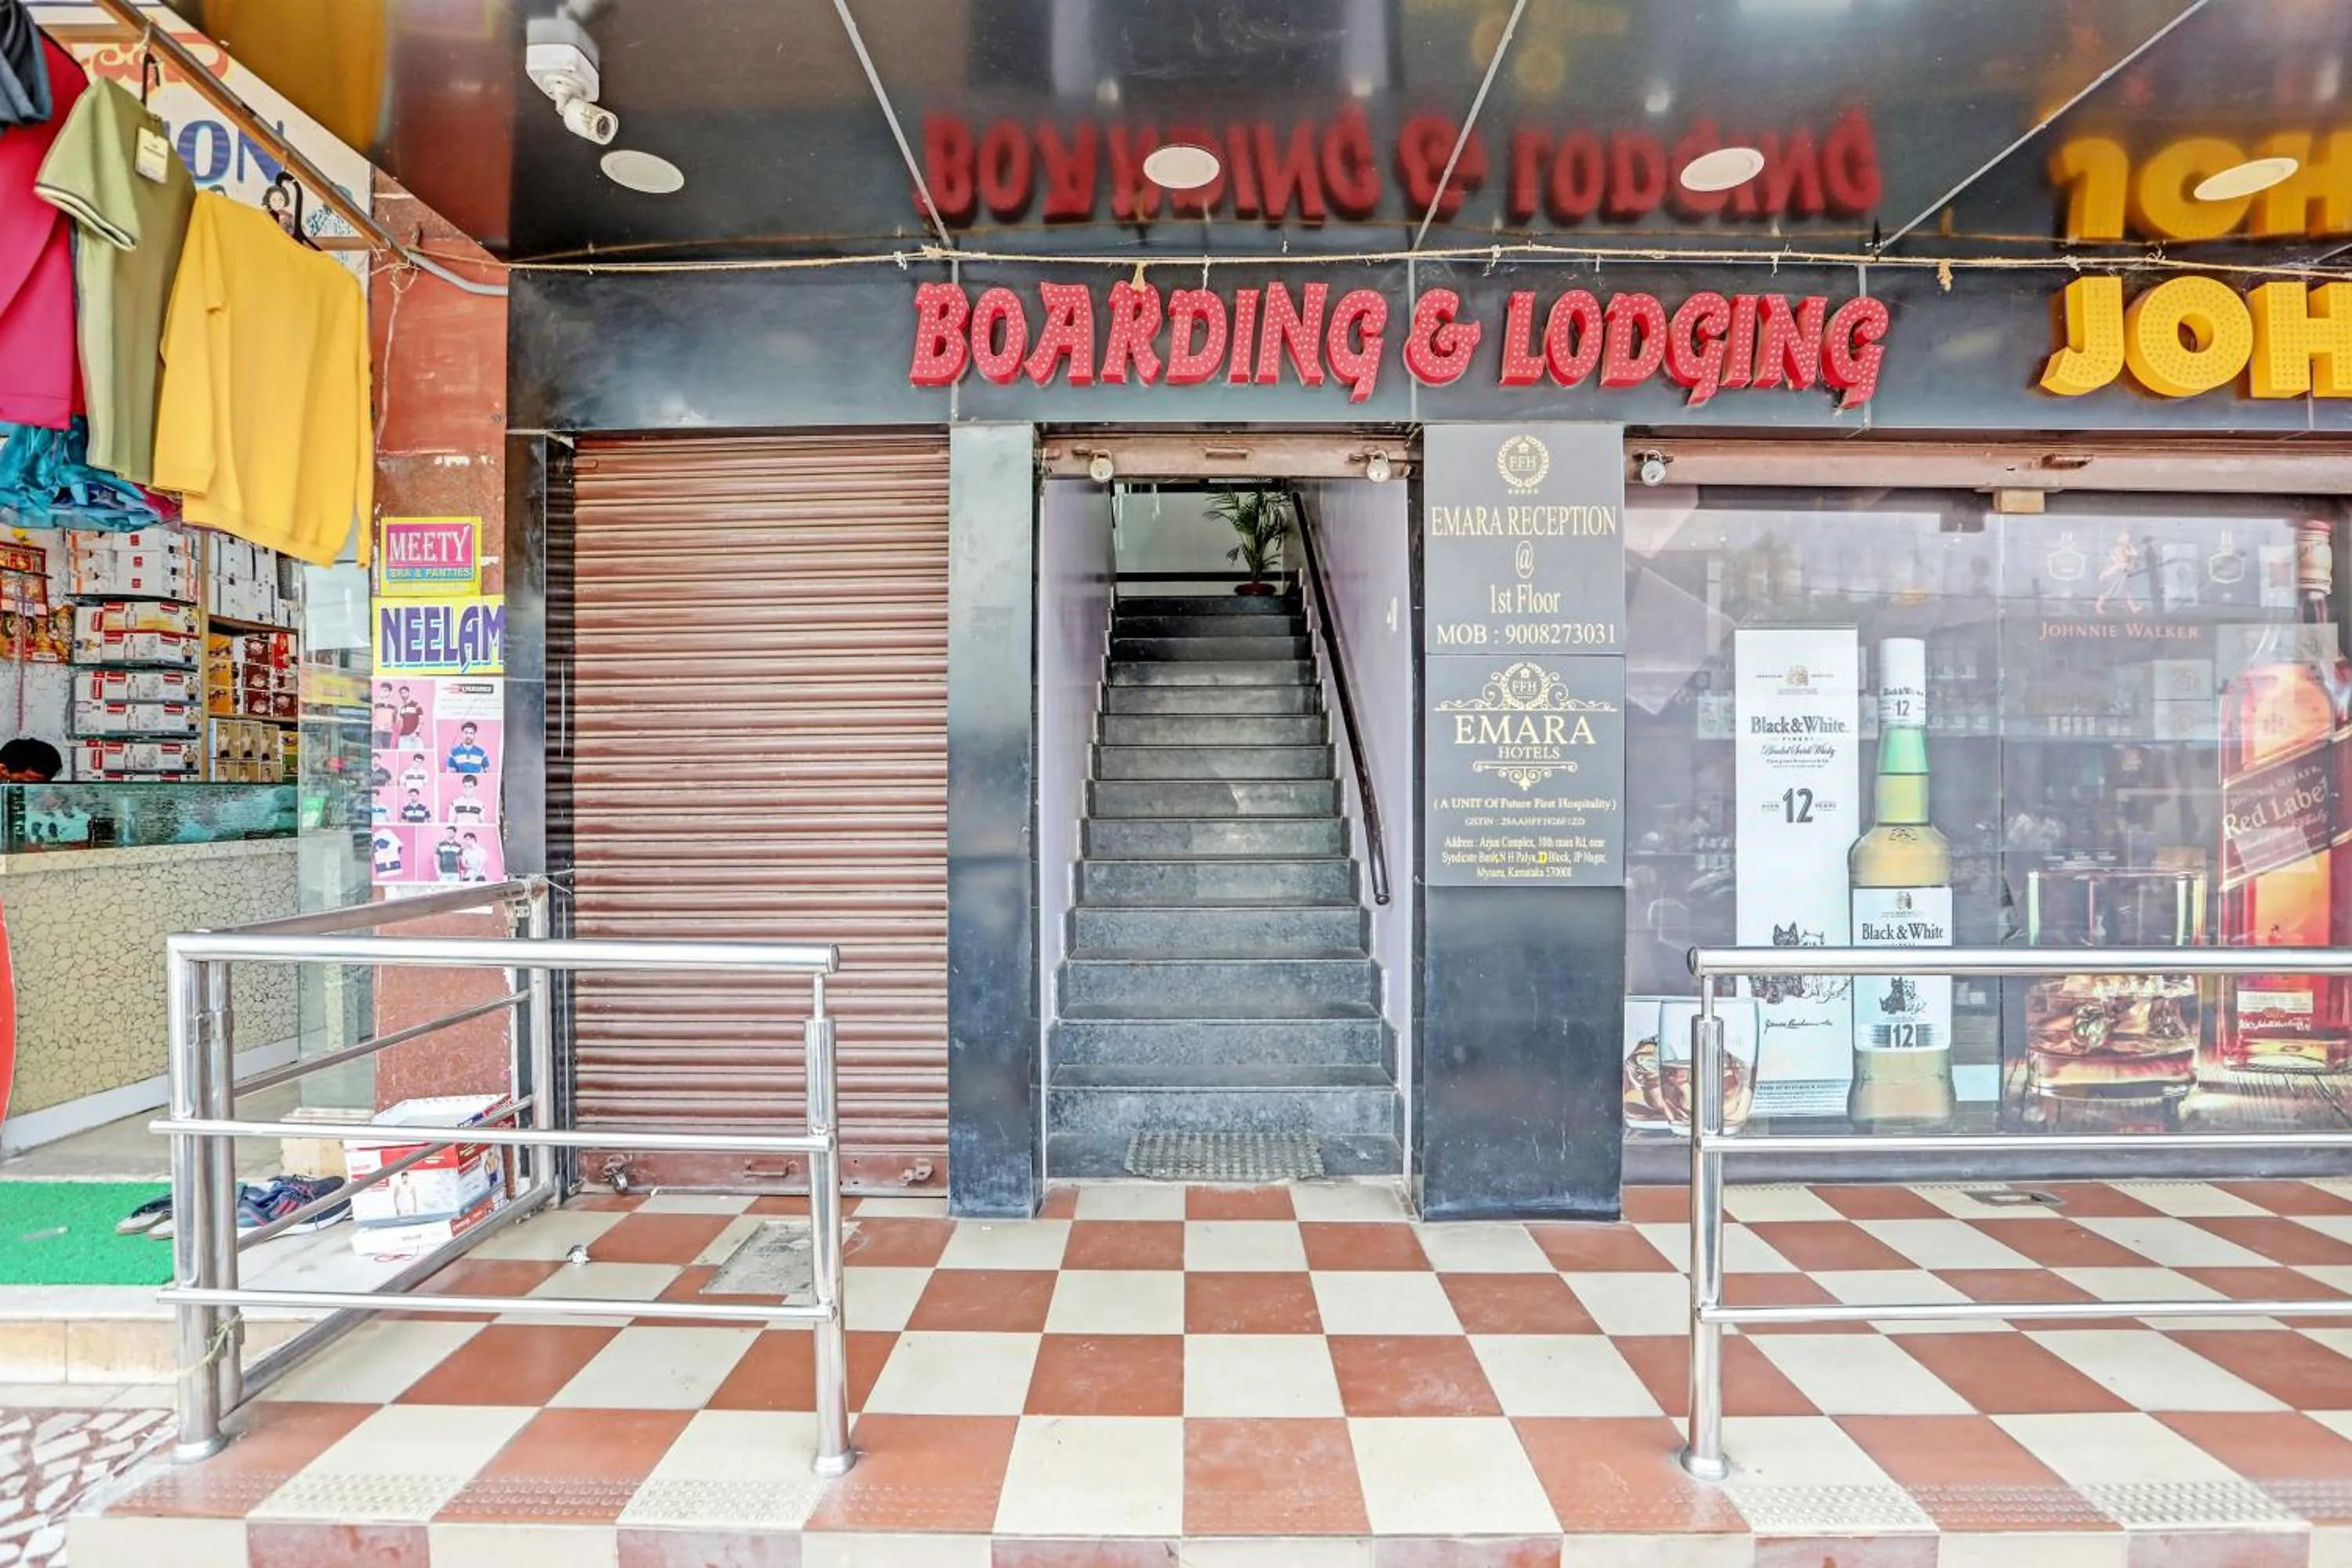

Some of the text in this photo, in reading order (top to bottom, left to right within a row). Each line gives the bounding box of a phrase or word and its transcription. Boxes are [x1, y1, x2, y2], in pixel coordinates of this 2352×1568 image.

[163, 120, 285, 183] ON
[909, 280, 1888, 409] BOARDING & LODGING
[1432, 506, 1617, 535] EMARA RECEPTION
[390, 525, 470, 562] MEETY
[1515, 540, 1534, 579] @
[1490, 584, 1561, 613] 1st Floor
[381, 602, 504, 671] NEELAM
[1436, 625, 1487, 644] MOB
[1505, 624, 1615, 644] 9008273031
[2039, 622, 2198, 640] JOHNNIE WALKER
[1896, 699, 1910, 716] 12
[1455, 715, 1596, 745] EMARA
[1498, 746, 1560, 760] HOTELS
[1451, 798, 1481, 808] UNIT
[1783, 788, 1813, 823] 12
[2223, 802, 2267, 840] Red
[2270, 775, 2329, 820] Label
[1892, 1024, 1914, 1047] 12
